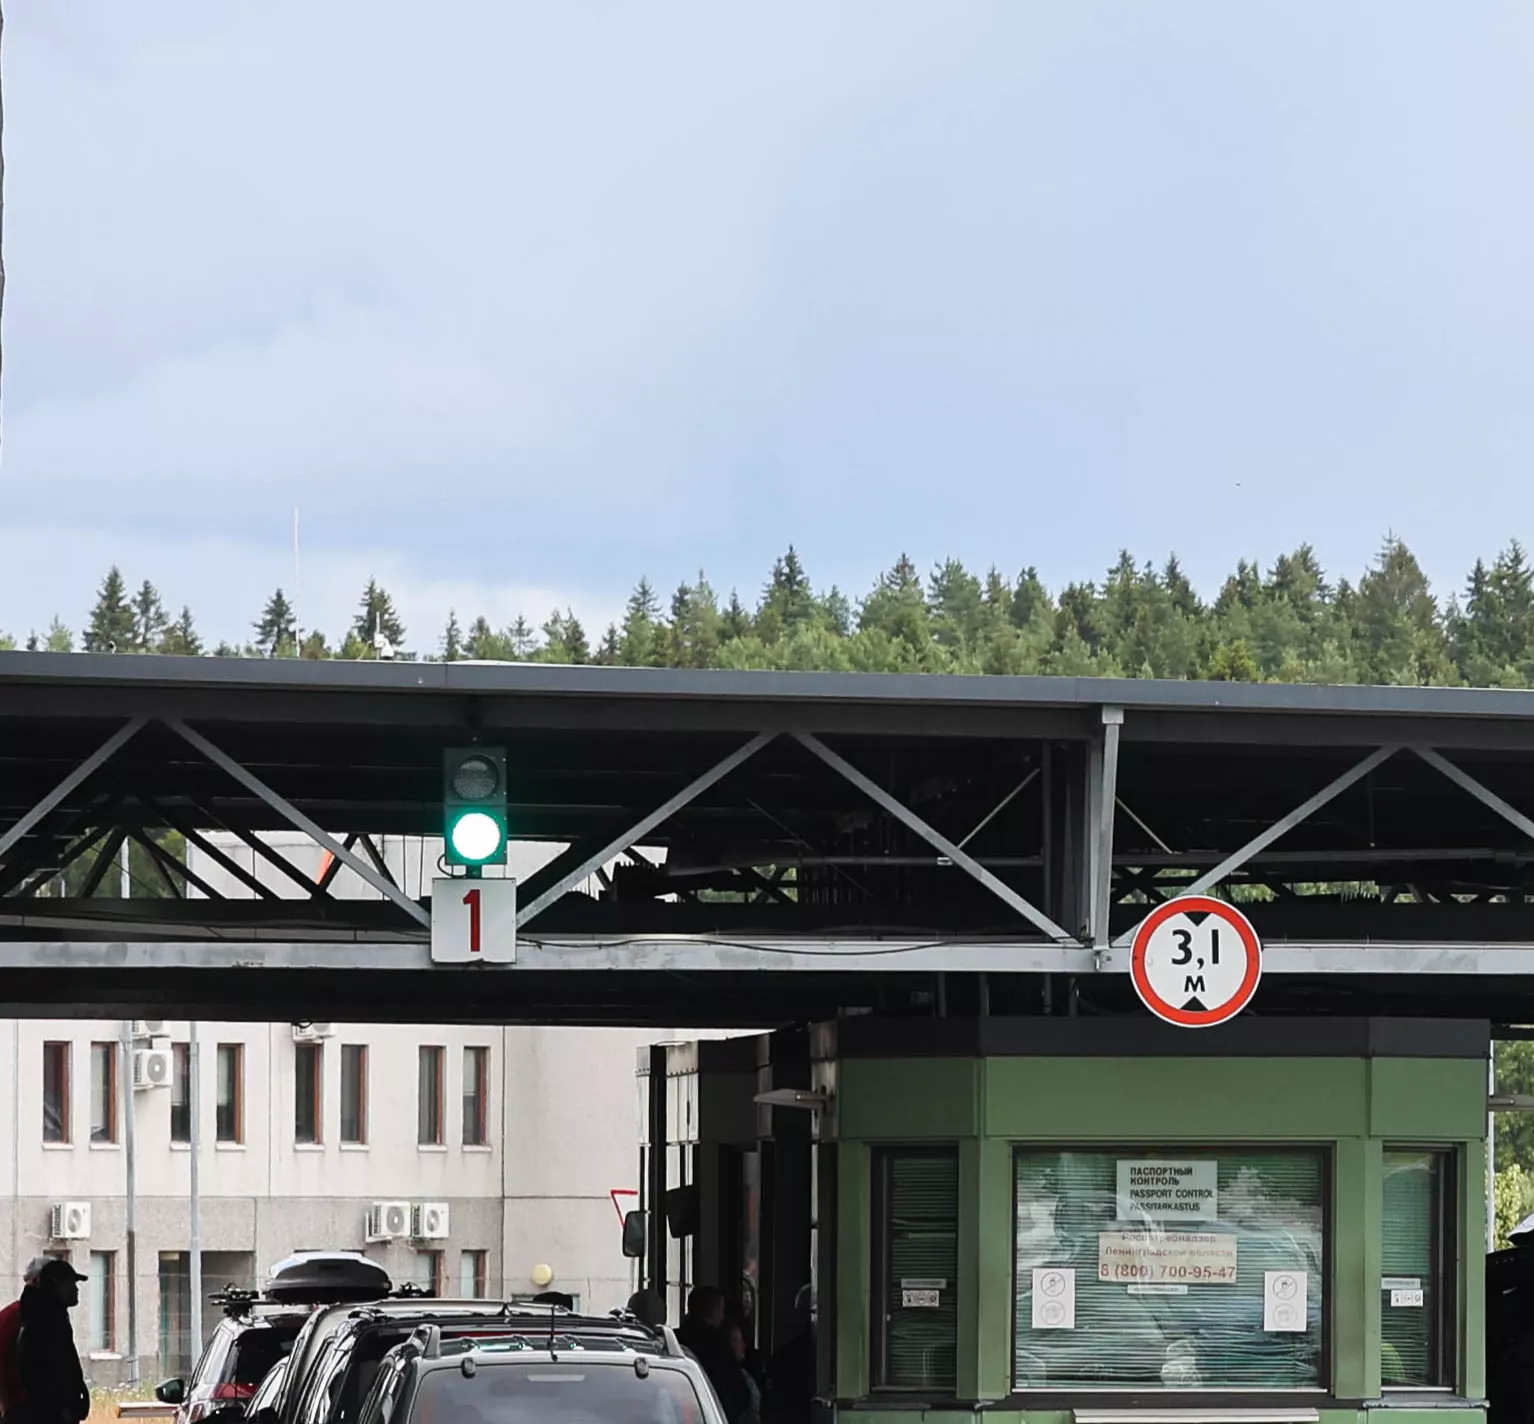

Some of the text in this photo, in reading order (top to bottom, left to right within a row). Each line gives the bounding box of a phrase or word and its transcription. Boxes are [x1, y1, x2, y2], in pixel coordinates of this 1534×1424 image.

[462, 889, 480, 952] 1
[1171, 929, 1219, 970] 3,1
[1130, 1167, 1193, 1176] ПАСПОРТНЫЙ
[1130, 1177, 1180, 1186] КОНТРОЛЬ
[1130, 1189, 1213, 1198] PASSPORT CONTROL
